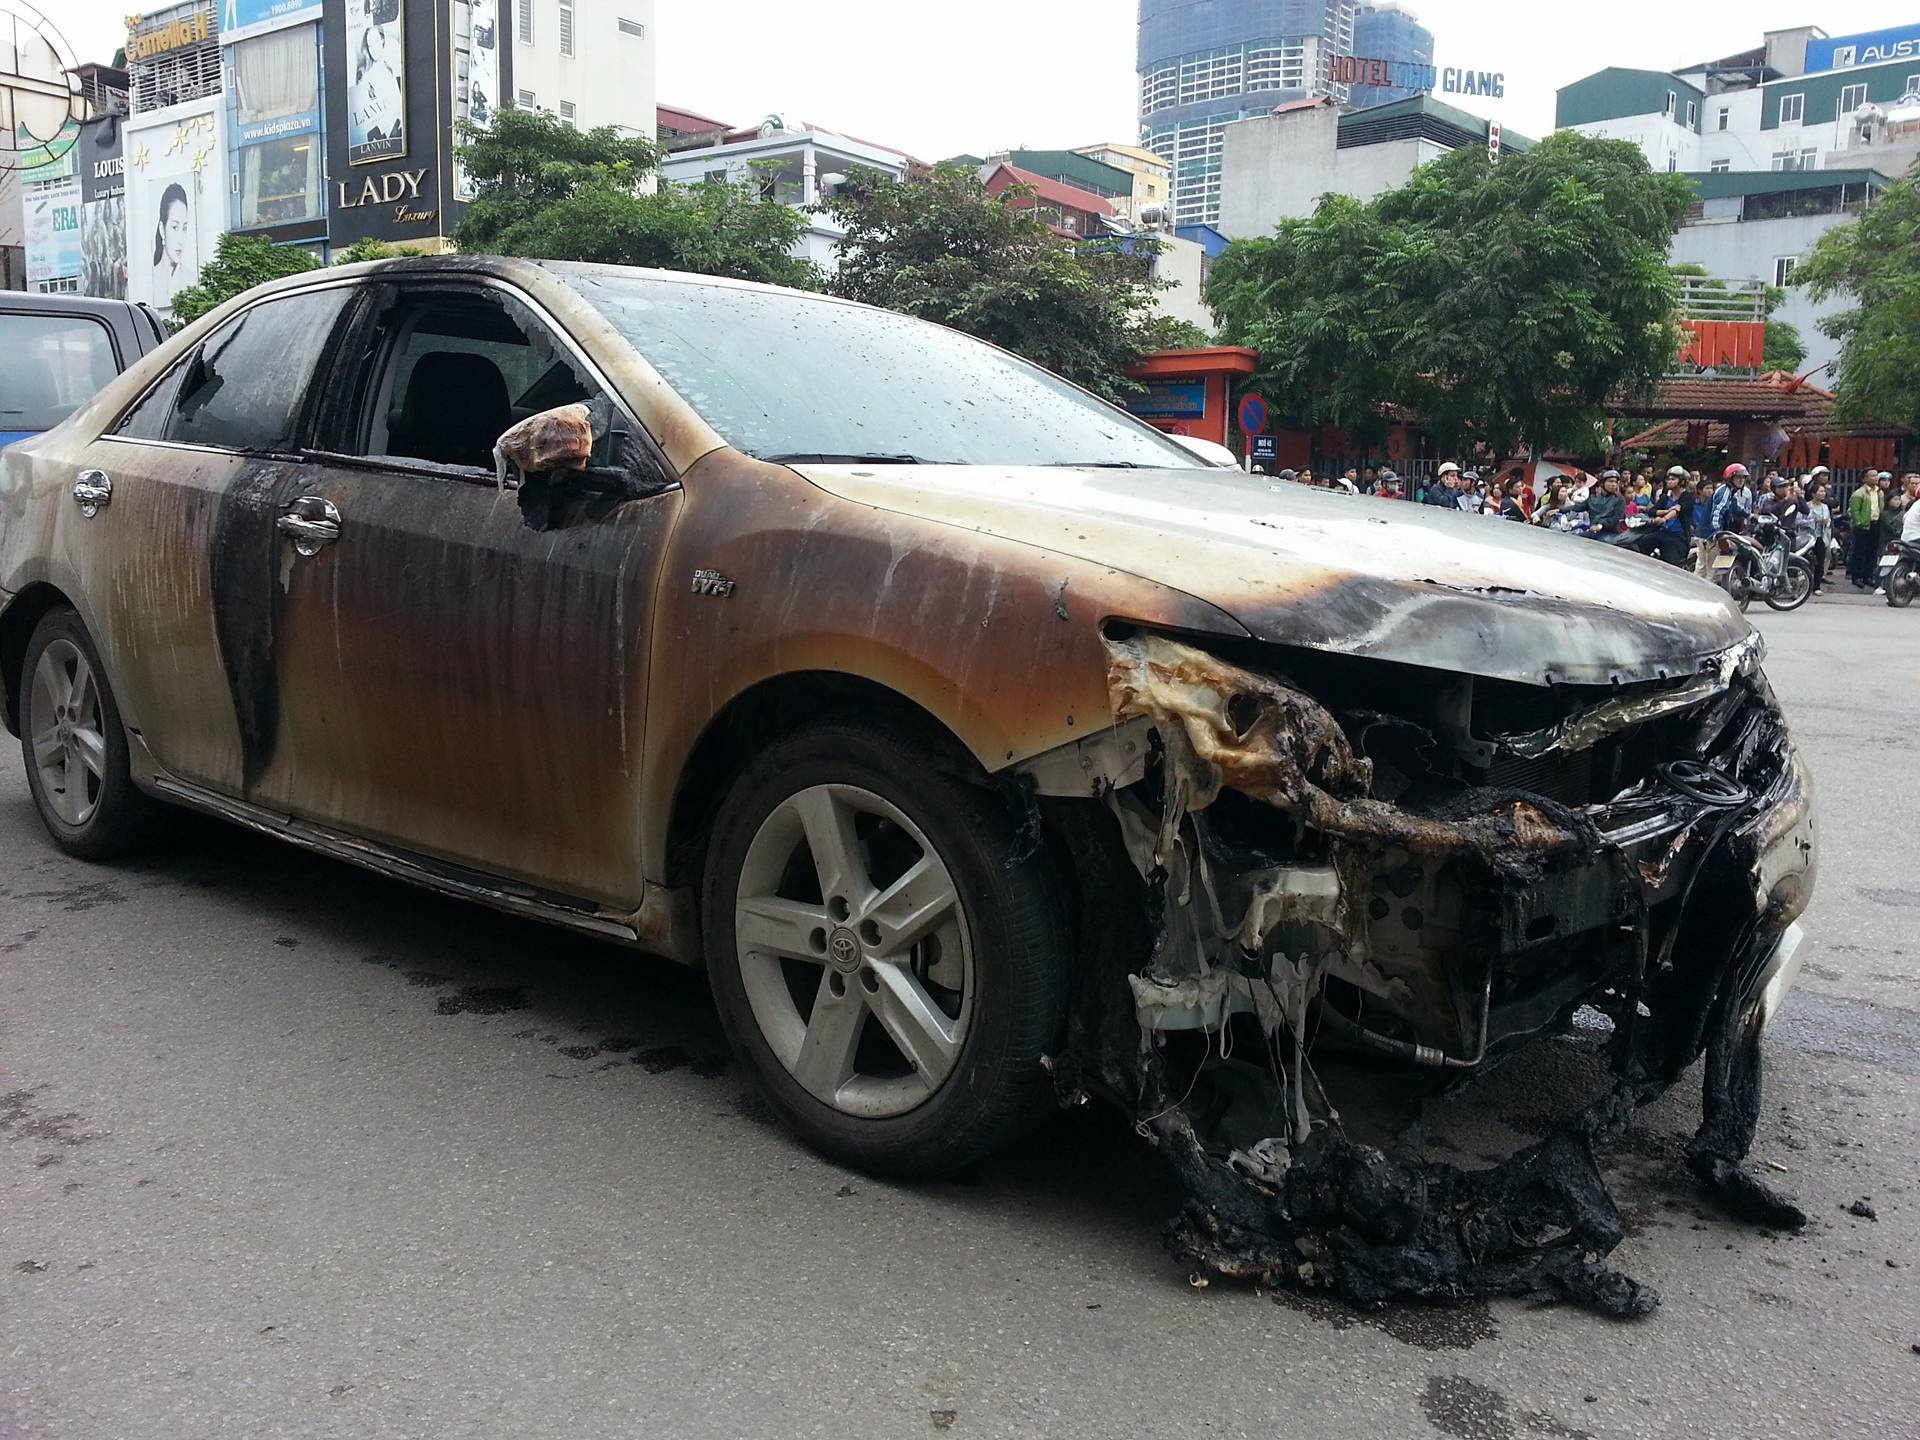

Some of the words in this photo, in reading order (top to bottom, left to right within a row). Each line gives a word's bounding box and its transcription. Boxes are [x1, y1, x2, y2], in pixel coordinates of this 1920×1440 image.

[125, 20, 193, 62] Camellia
[1328, 54, 1392, 87] HOTEL
[1443, 67, 1504, 98] GIANG
[243, 117, 311, 140] www.kidsplaza.vn
[360, 140, 392, 154] LANVIN
[94, 156, 124, 178] LOUIS
[337, 167, 429, 209] LADY
[52, 205, 79, 232] ERA
[393, 204, 435, 225] Luxury
